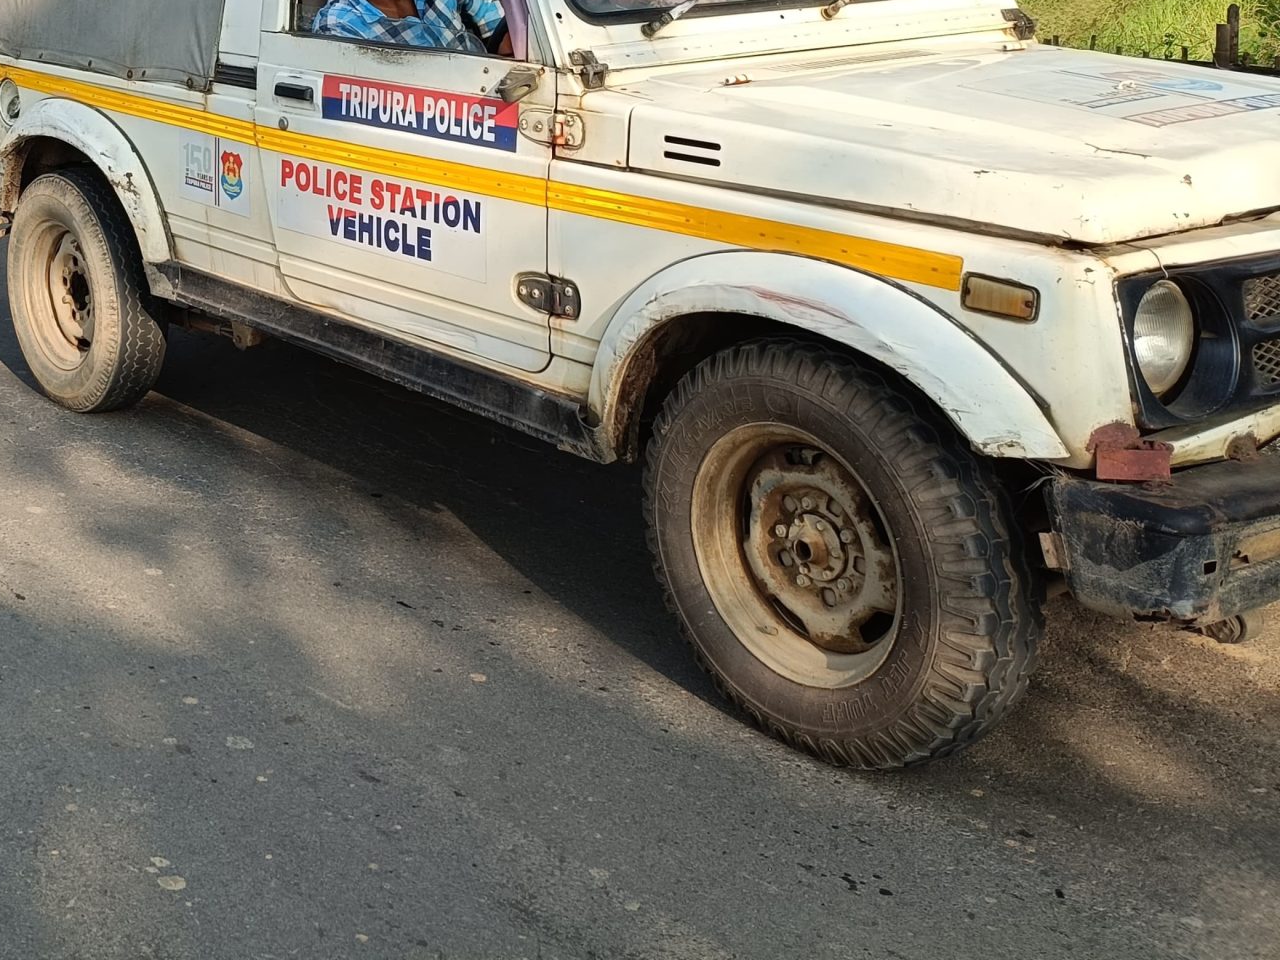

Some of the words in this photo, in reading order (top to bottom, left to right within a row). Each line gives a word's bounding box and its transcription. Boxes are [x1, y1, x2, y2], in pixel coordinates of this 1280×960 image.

[339, 83, 418, 129] TRIPURA
[422, 97, 497, 142] POLICE
[183, 142, 211, 174] 150
[281, 159, 362, 205] POLICE
[370, 178, 481, 234] STATION
[327, 204, 432, 262] VEHICLE
